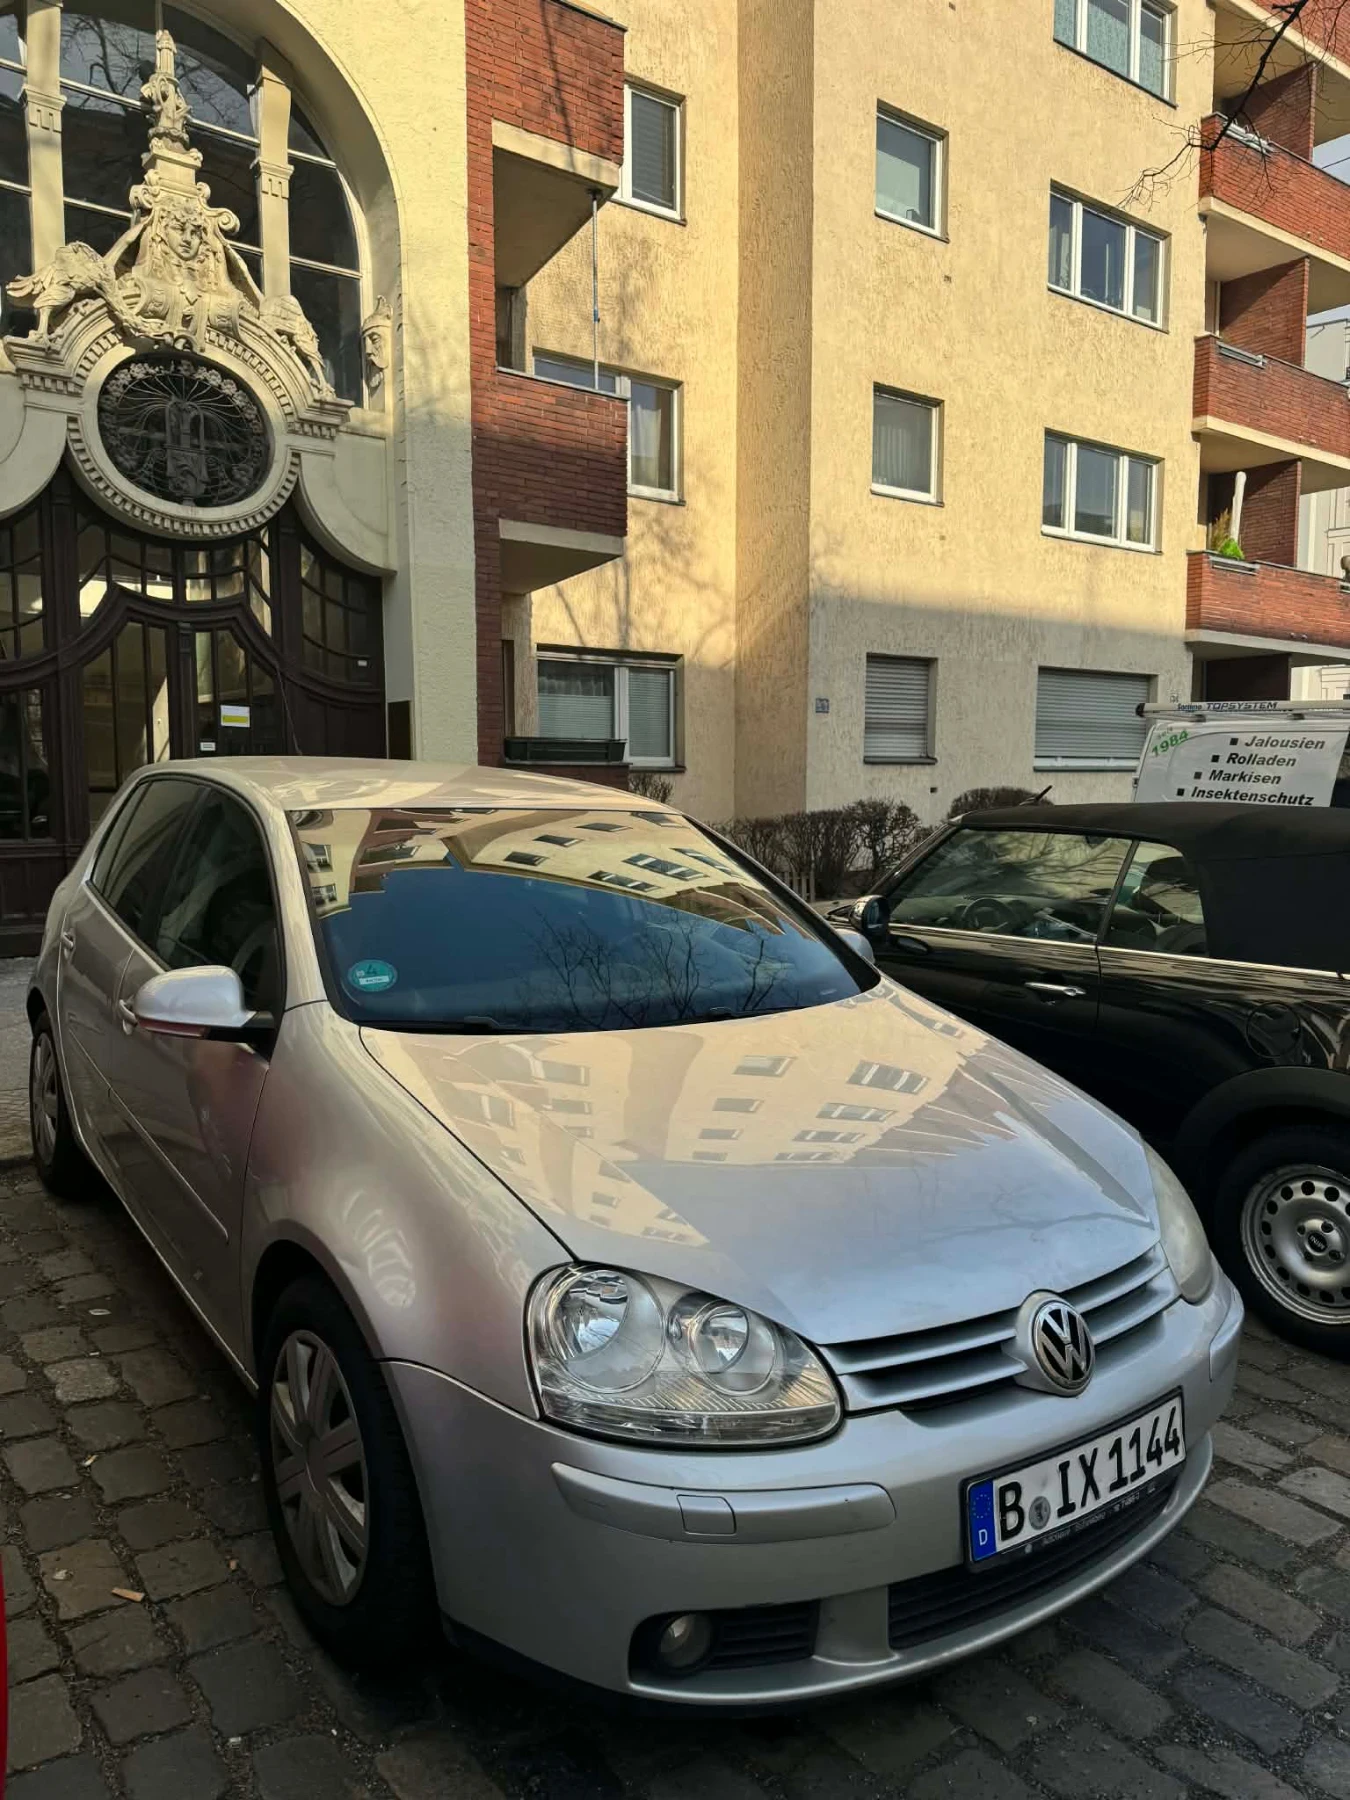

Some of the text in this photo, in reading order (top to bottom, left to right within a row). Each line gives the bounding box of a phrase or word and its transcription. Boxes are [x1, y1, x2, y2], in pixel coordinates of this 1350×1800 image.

[1206, 701, 1279, 711] TOPSYSTEM
[1151, 730, 1189, 757] 1984
[1244, 735, 1326, 750] Jalousien
[1226, 752, 1297, 767] Rolladen
[1208, 769, 1282, 785] Markisen
[1191, 786, 1315, 806] Insektenschutz
[366, 964, 377, 975] 4
[998, 1480, 1025, 1541] B
[1057, 1447, 1101, 1518] IX
[1108, 1406, 1180, 1492] 1144
[978, 1528, 988, 1546] D
